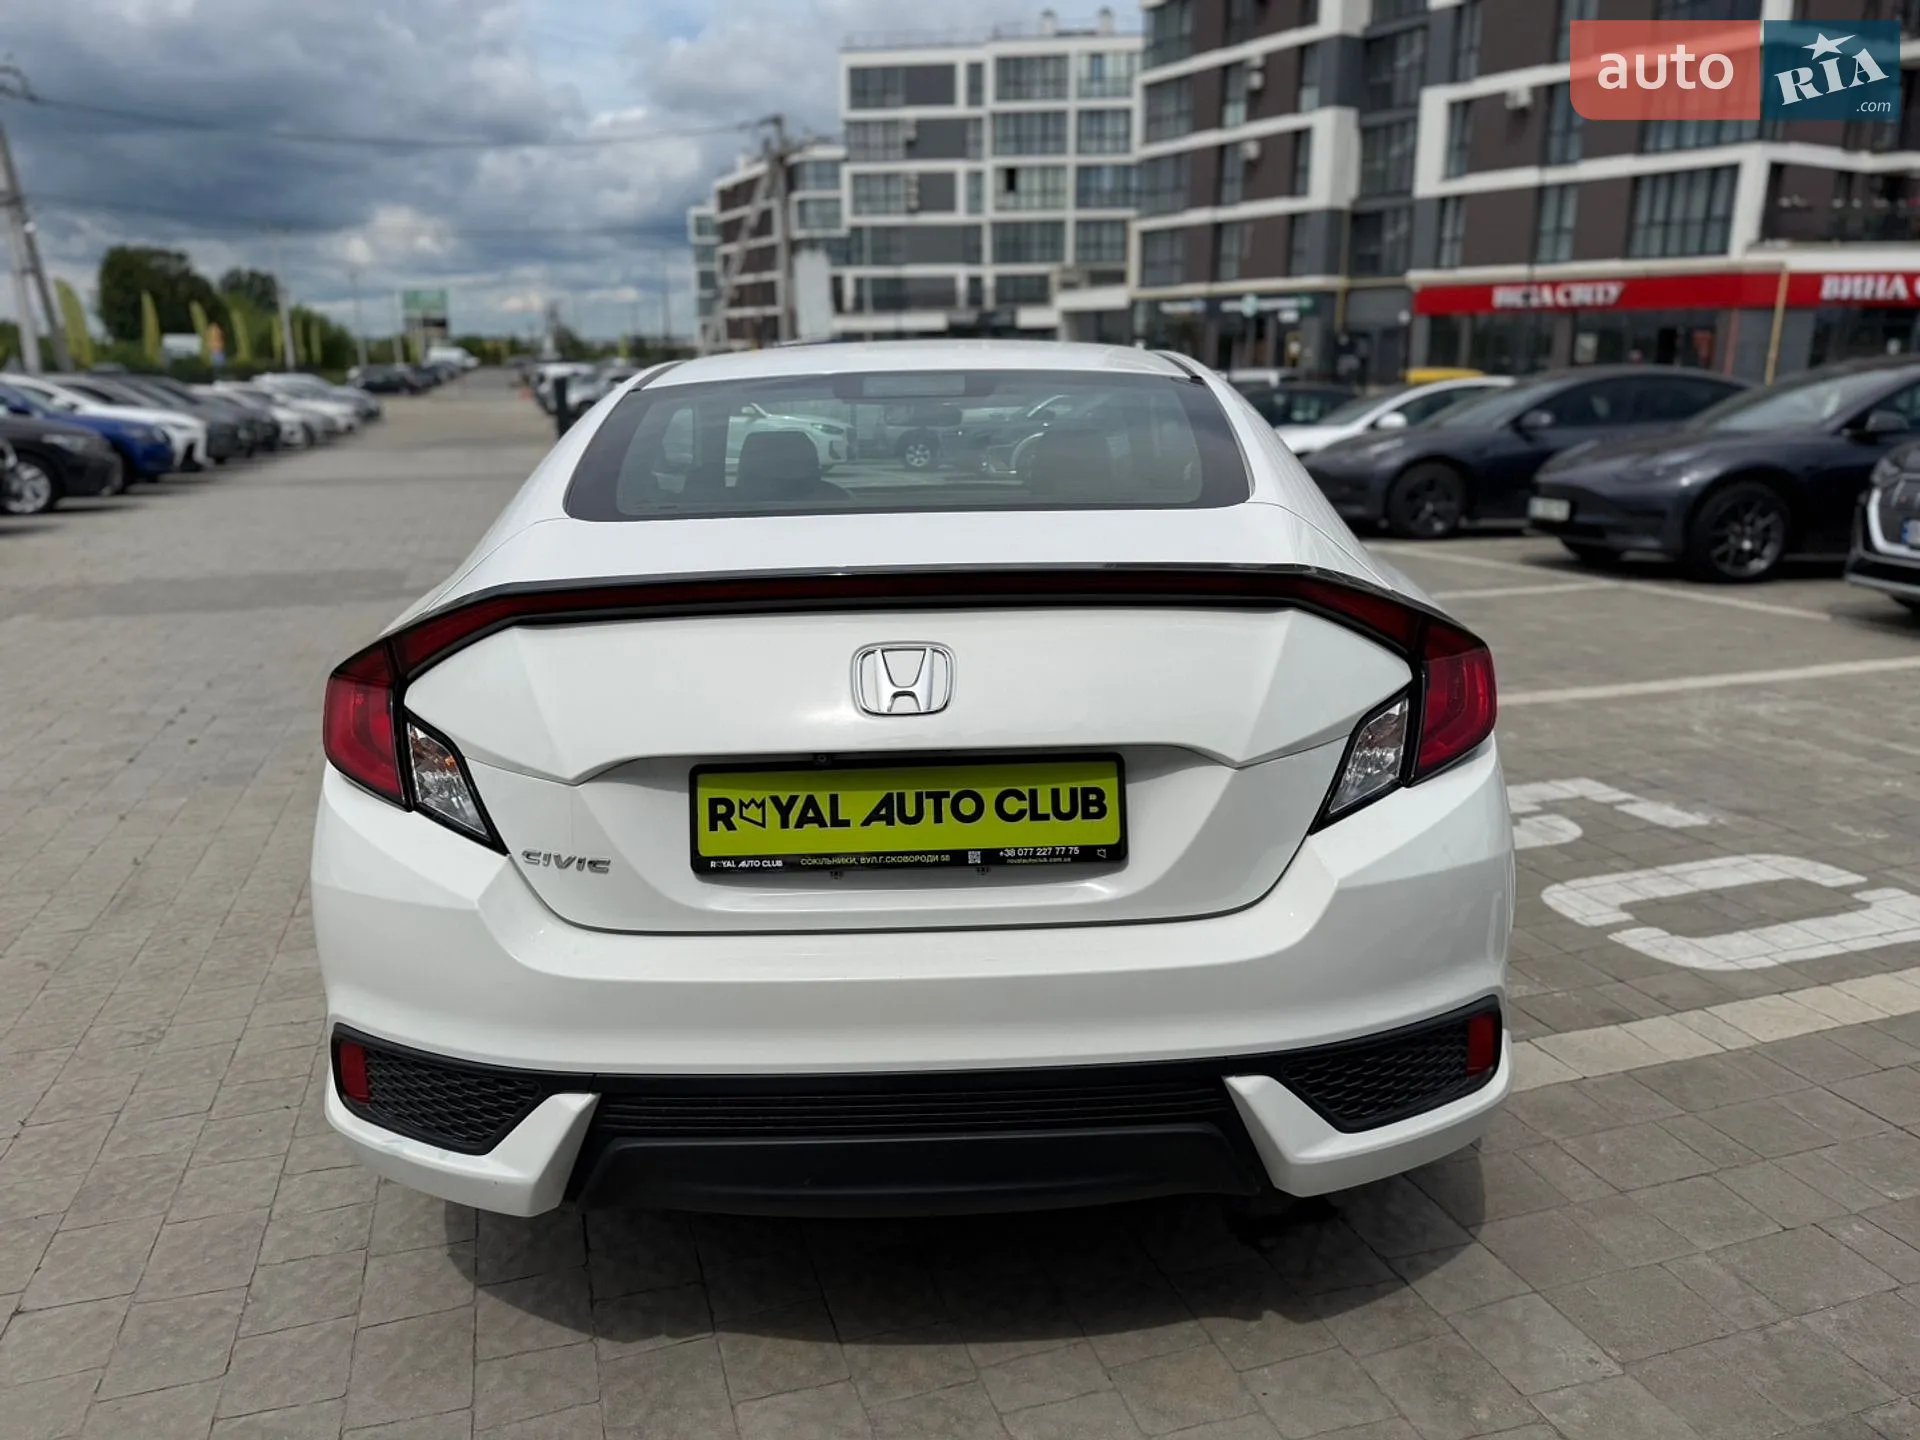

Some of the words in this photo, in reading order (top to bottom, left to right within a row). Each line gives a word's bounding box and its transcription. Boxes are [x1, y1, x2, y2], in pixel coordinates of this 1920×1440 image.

[860, 787, 985, 828] AUTO
[994, 786, 1109, 824] CLUB
[521, 849, 612, 875] CIVIC
[738, 859, 761, 868] AUTO
[762, 858, 783, 868] CLUB
